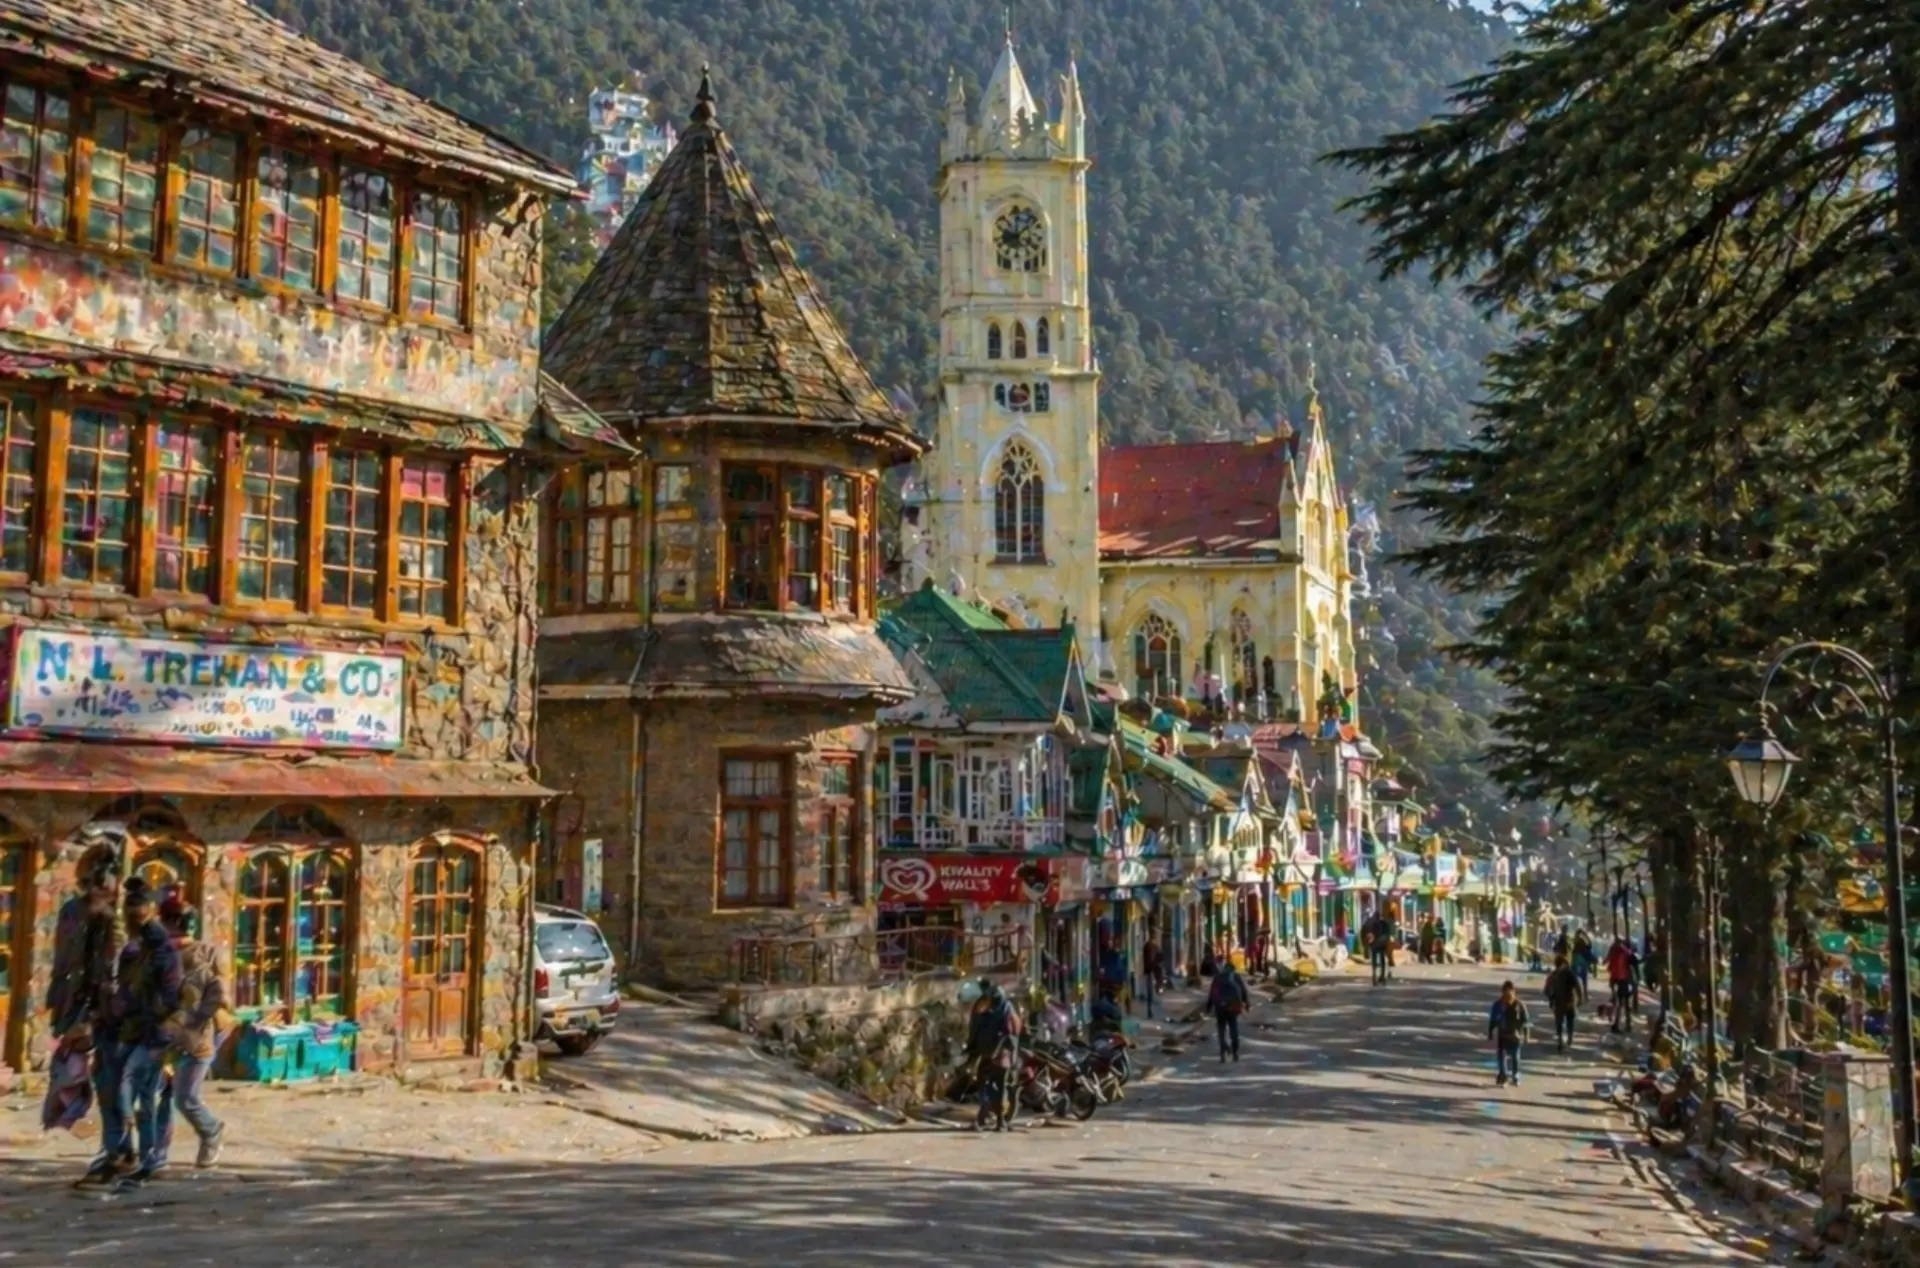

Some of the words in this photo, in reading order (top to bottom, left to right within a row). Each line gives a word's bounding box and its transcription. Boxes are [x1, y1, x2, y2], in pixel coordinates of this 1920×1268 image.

[37, 639, 75, 682] N.
[92, 645, 125, 682] L.
[141, 649, 288, 690] TREHAN
[302, 662, 326, 694] &
[940, 865, 1003, 878] KWALITY
[941, 878, 991, 892] WALL'S
